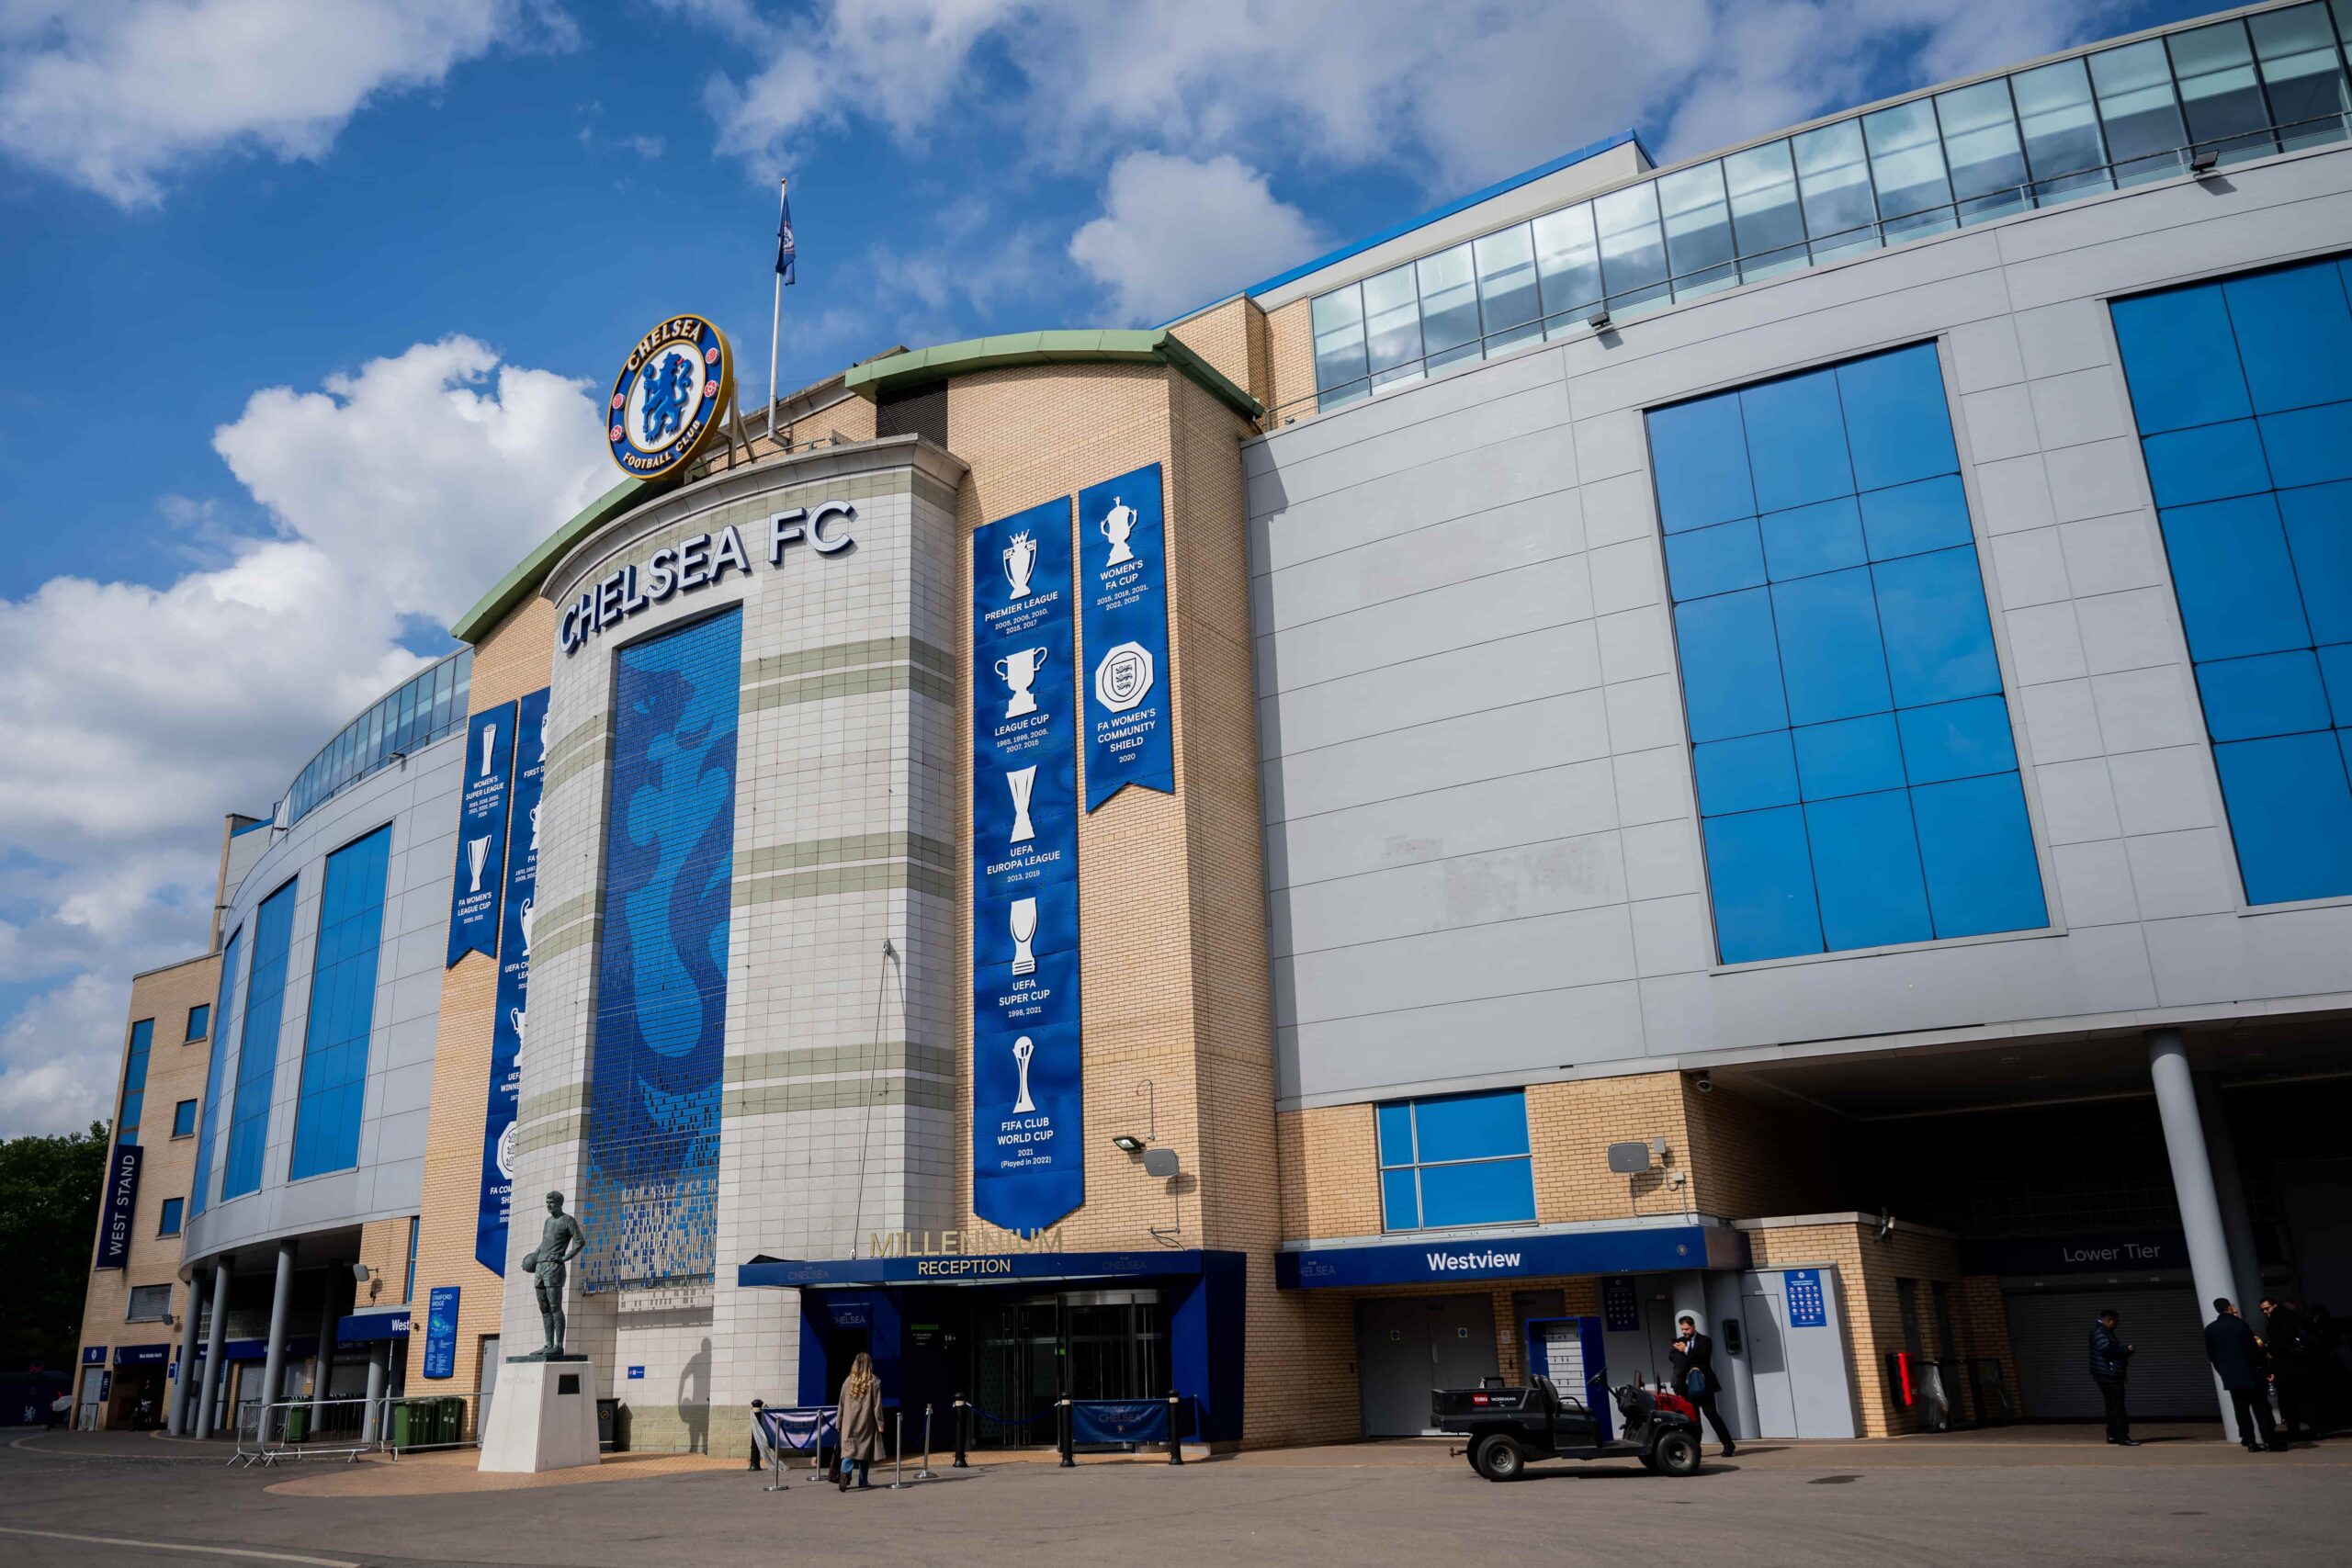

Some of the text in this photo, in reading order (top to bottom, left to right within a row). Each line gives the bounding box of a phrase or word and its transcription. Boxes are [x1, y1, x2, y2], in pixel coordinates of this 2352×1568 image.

[628, 319, 702, 371] CHELSEA
[623, 421, 701, 469] FOOTBALL CLUB
[559, 500, 857, 654] CHELSEA FC
[1100, 559, 1144, 581] WOMEN'S
[1105, 572, 1138, 591] FA CUP
[985, 591, 1058, 622] PREMIER LEAGUE
[1023, 619, 1037, 629] 2017
[994, 714, 1049, 737] LEAGUE CUP
[1097, 707, 1157, 732] FA WOMEN'S
[1098, 720, 1156, 743] COMMUNITY
[1006, 743, 1023, 753] 2007,
[1110, 737, 1144, 752] SHIELD
[1118, 752, 1136, 763] 2020
[524, 766, 540, 779] FIRST
[473, 775, 498, 789] WOMEN'S
[466, 782, 504, 801] SUPER LEAGUE
[1010, 844, 1034, 857] UEFA
[527, 854, 536, 863] FA
[987, 851, 1061, 875] EUROPA LEAGUE
[1007, 870, 1040, 883] 2013, 2019
[458, 891, 492, 908] FA WOMEN'S
[458, 901, 492, 917] LEAGUE CUP
[504, 963, 520, 974] UEFA
[517, 971, 529, 980] LEA
[1012, 979, 1036, 991] UEFA
[999, 989, 1051, 1007] SUPER CUP
[1008, 1006, 1042, 1018] 1998, 2021
[508, 1071, 521, 1081] UEF
[500, 1082, 520, 1093] WINNE
[1001, 1117, 1050, 1132] FIFA CLUB
[998, 1130, 1054, 1145] WORLD CUP
[1017, 1148, 1034, 1156] 2021
[1001, 1158, 1024, 1169] (Played
[1033, 1156, 1052, 1166] 2022)
[490, 1187, 498, 1195] FA
[108, 1155, 135, 1257] WEST STAND
[869, 1226, 1063, 1258] MILLENNIUM
[2063, 1243, 2162, 1262] Lower Tier
[918, 1258, 1012, 1276] RECEPTION
[1102, 1259, 1148, 1271] CHELSEA
[1426, 1249, 1521, 1271] Westview
[787, 1269, 830, 1280] CHELSEA
[1290, 1264, 1337, 1278] HELSEA
[391, 1319, 410, 1332] West
[1098, 1412, 1141, 1423] CHELSEA
